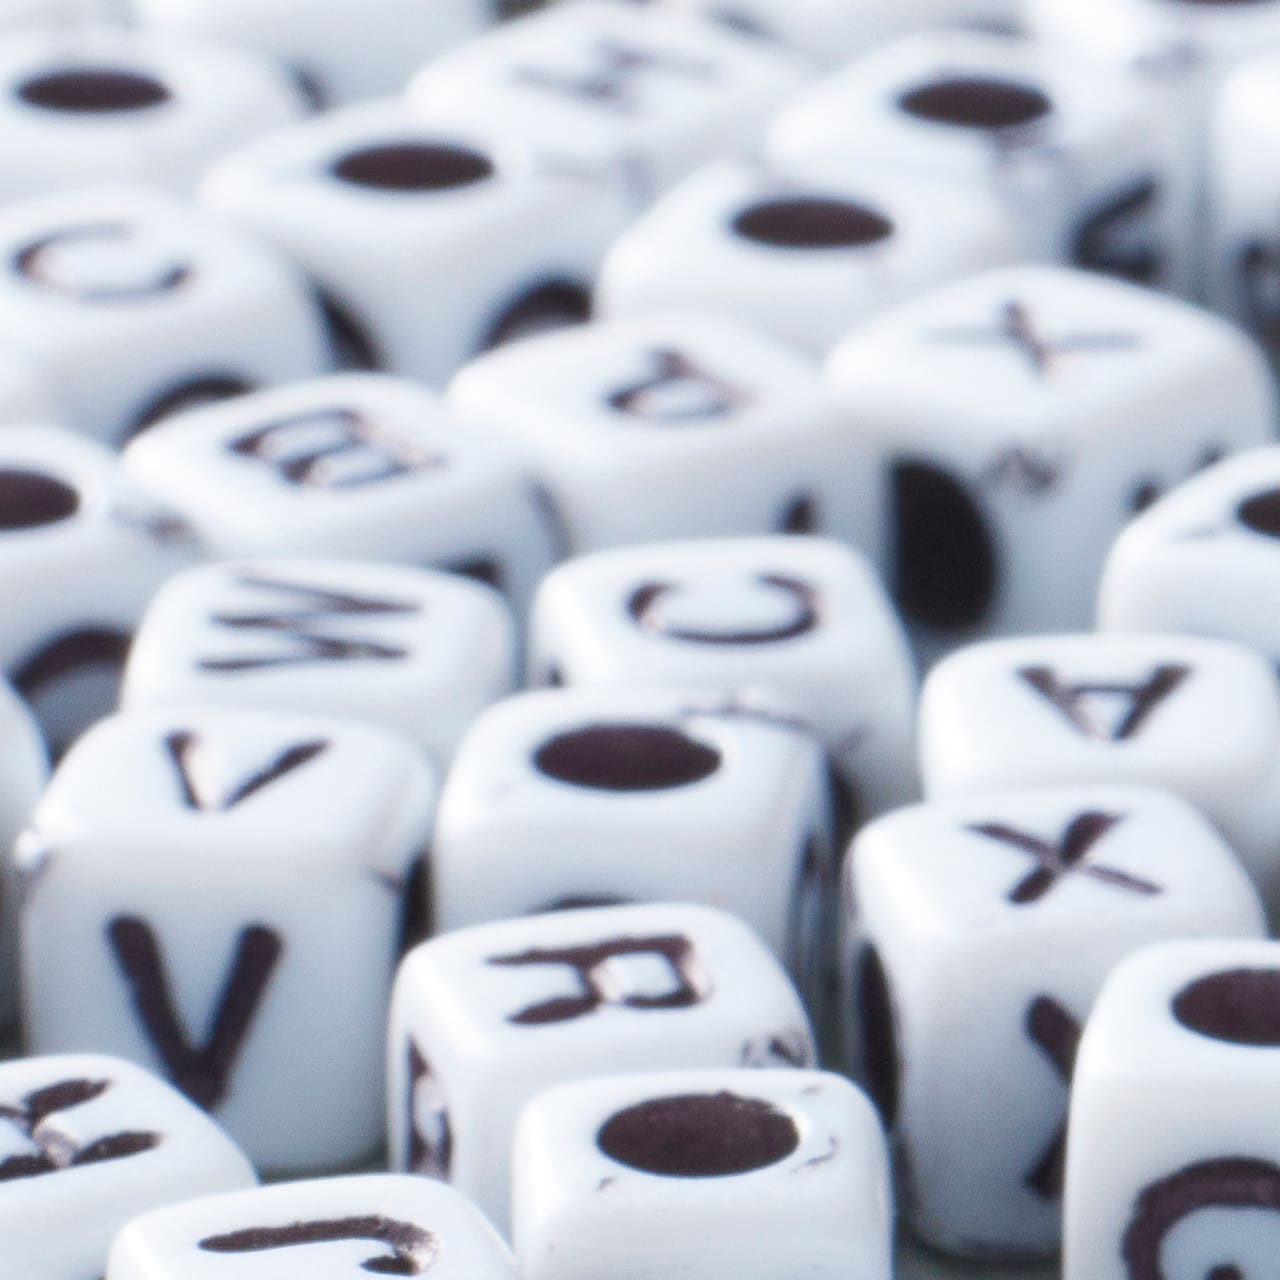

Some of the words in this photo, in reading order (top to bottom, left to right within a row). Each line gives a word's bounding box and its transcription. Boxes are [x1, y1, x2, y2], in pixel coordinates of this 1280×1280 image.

[625, 570, 823, 646] C
[1014, 663, 1194, 742] A
[164, 729, 332, 813] V
[965, 812, 1166, 905] X
[107, 915, 283, 1111] V
[484, 933, 714, 1029] R
[198, 1214, 443, 1275] J
